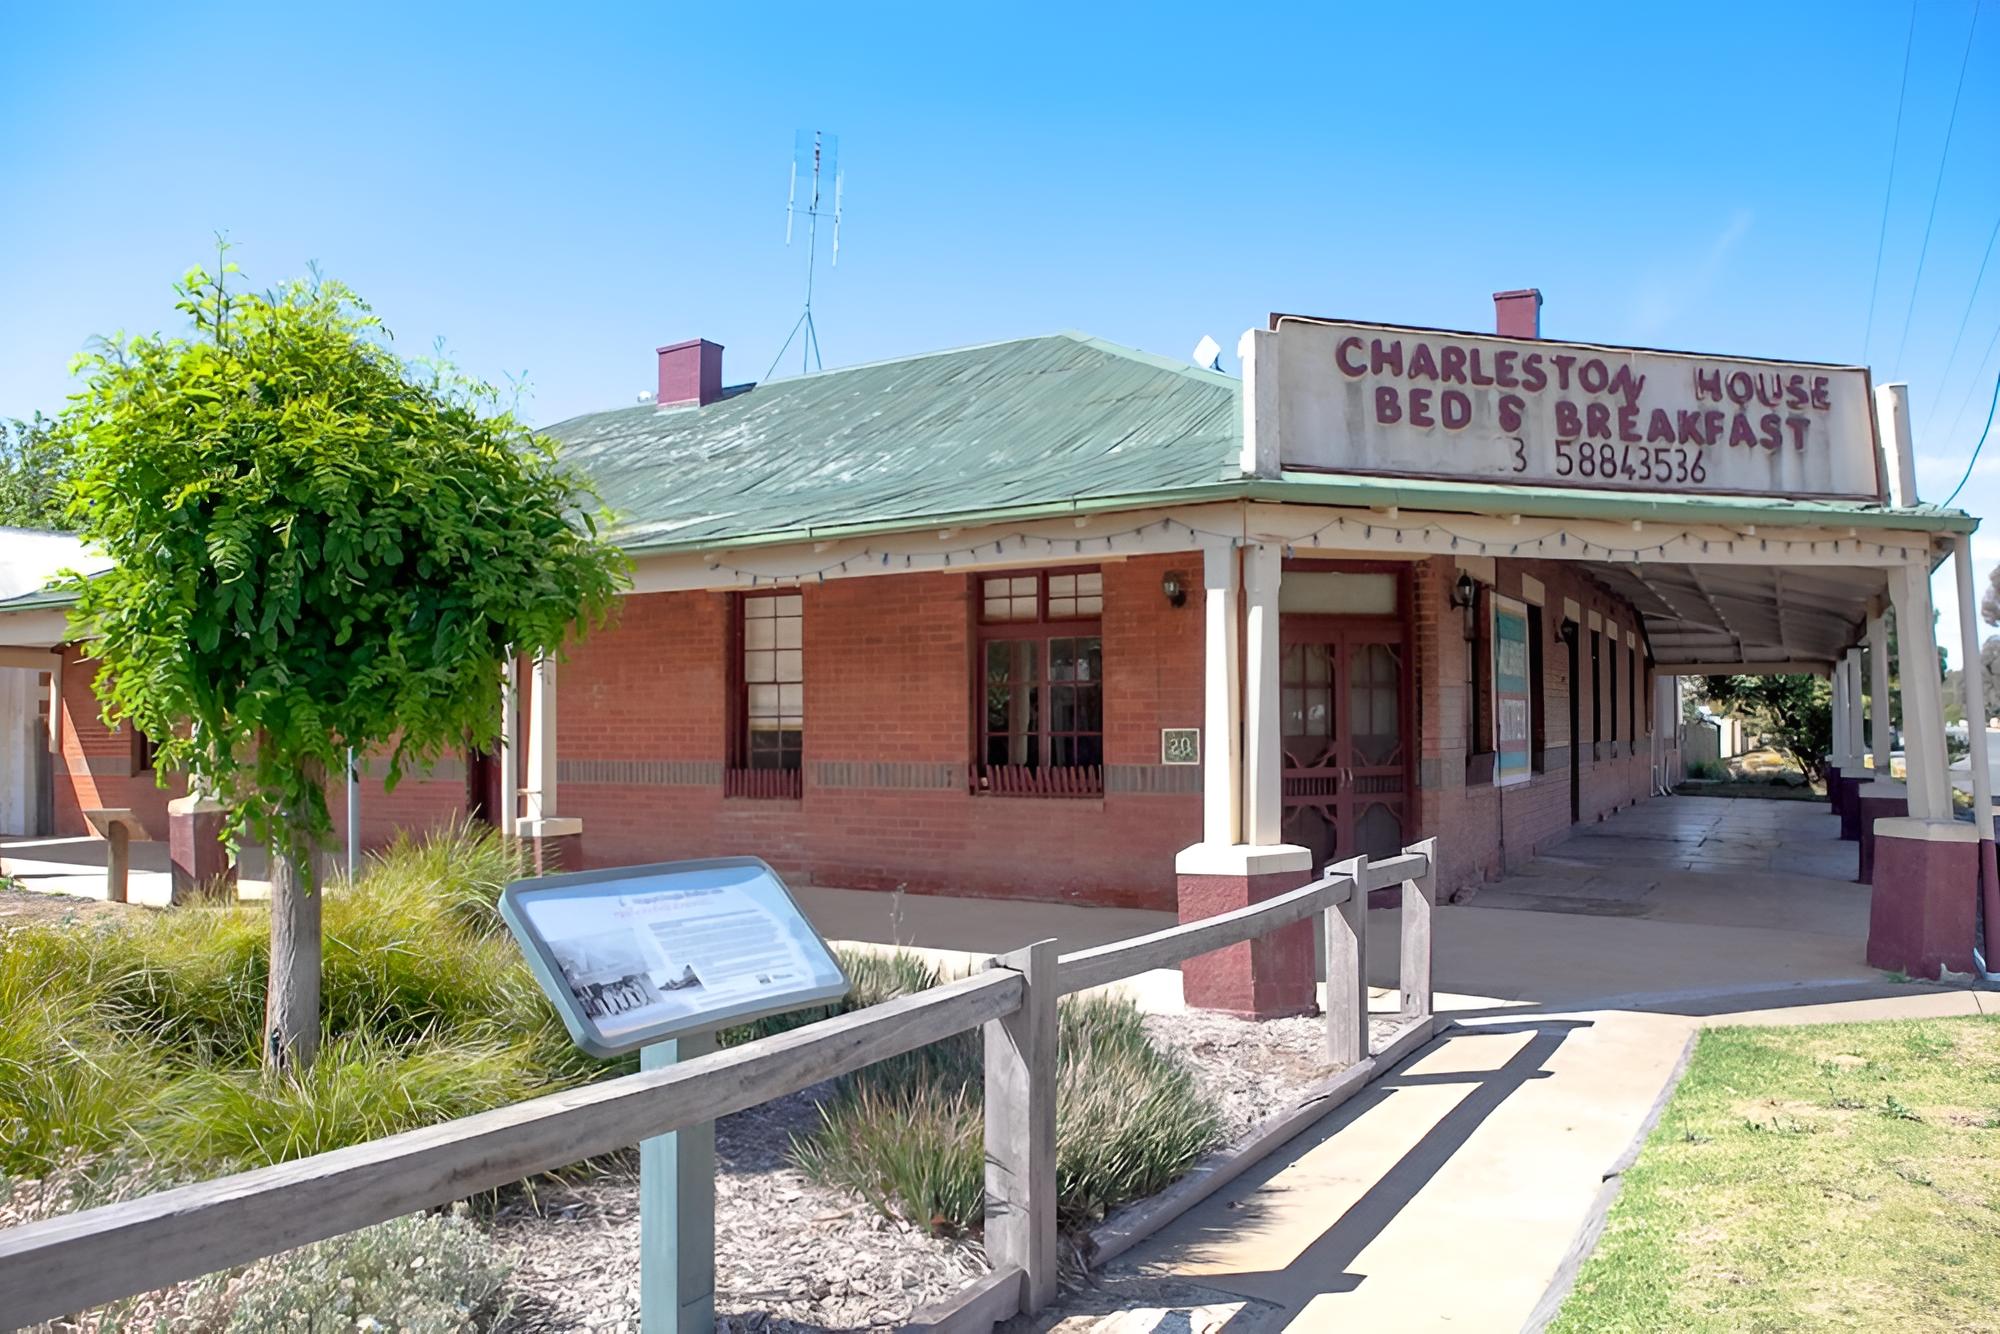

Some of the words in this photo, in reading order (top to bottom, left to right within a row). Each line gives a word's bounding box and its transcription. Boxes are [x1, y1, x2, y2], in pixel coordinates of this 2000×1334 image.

[1335, 336, 1646, 402] CHARLESTON
[1694, 367, 1831, 411] HOUSE
[1375, 386, 1471, 430] BED
[1555, 400, 1811, 451] BREAKFAST
[1555, 440, 1707, 484] 58843536
